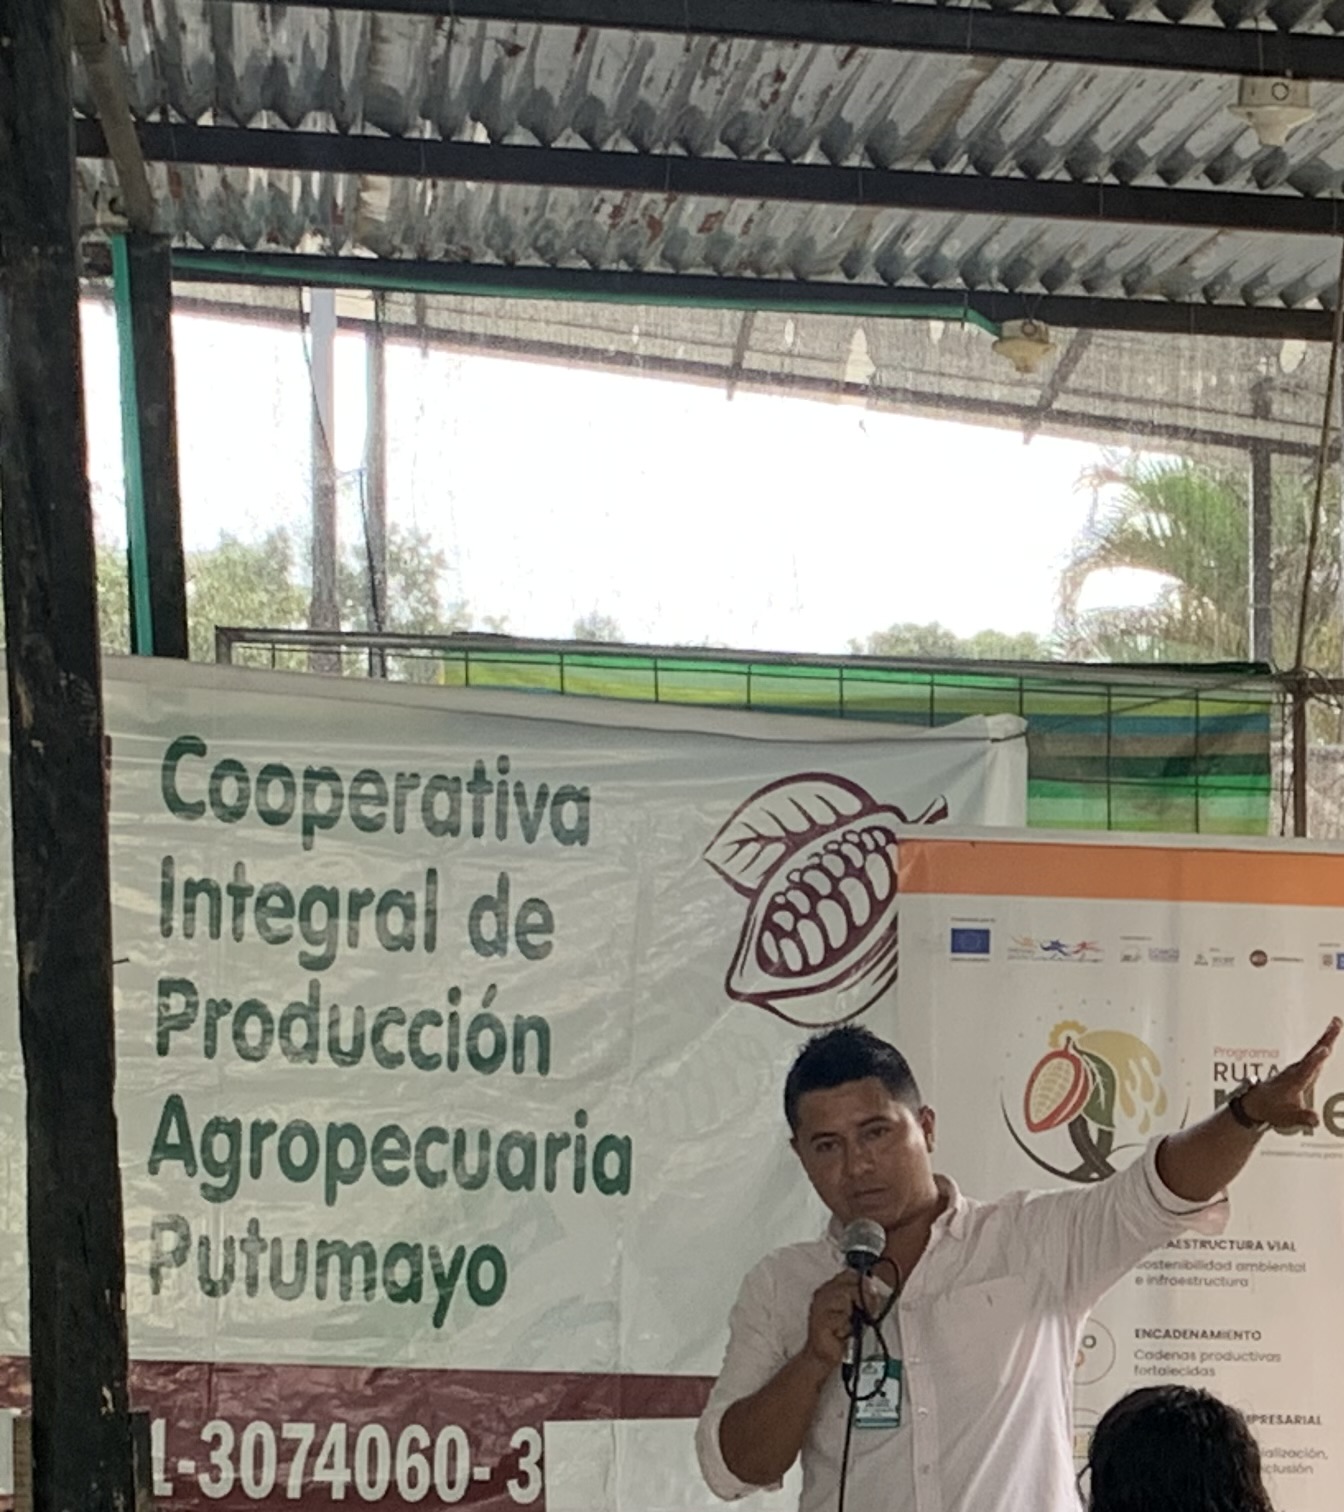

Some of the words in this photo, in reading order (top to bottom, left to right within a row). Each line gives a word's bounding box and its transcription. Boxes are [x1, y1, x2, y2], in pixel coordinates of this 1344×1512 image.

[160, 734, 592, 850] Cooperativa
[159, 855, 437, 971] Integral
[468, 872, 556, 961] de
[156, 976, 552, 1077] Producción
[1213, 1046, 1280, 1061] Programa
[148, 1093, 633, 1206] Agropecuaria
[148, 1213, 508, 1327] Putumayo
[1235, 1259, 1307, 1273] ambiental
[1267, 1239, 1297, 1252] VIAL
[1133, 1348, 1197, 1361] Cadenas
[1199, 1350, 1282, 1364] productivas
[1134, 1327, 1262, 1341] ENCADENAMIENTO
